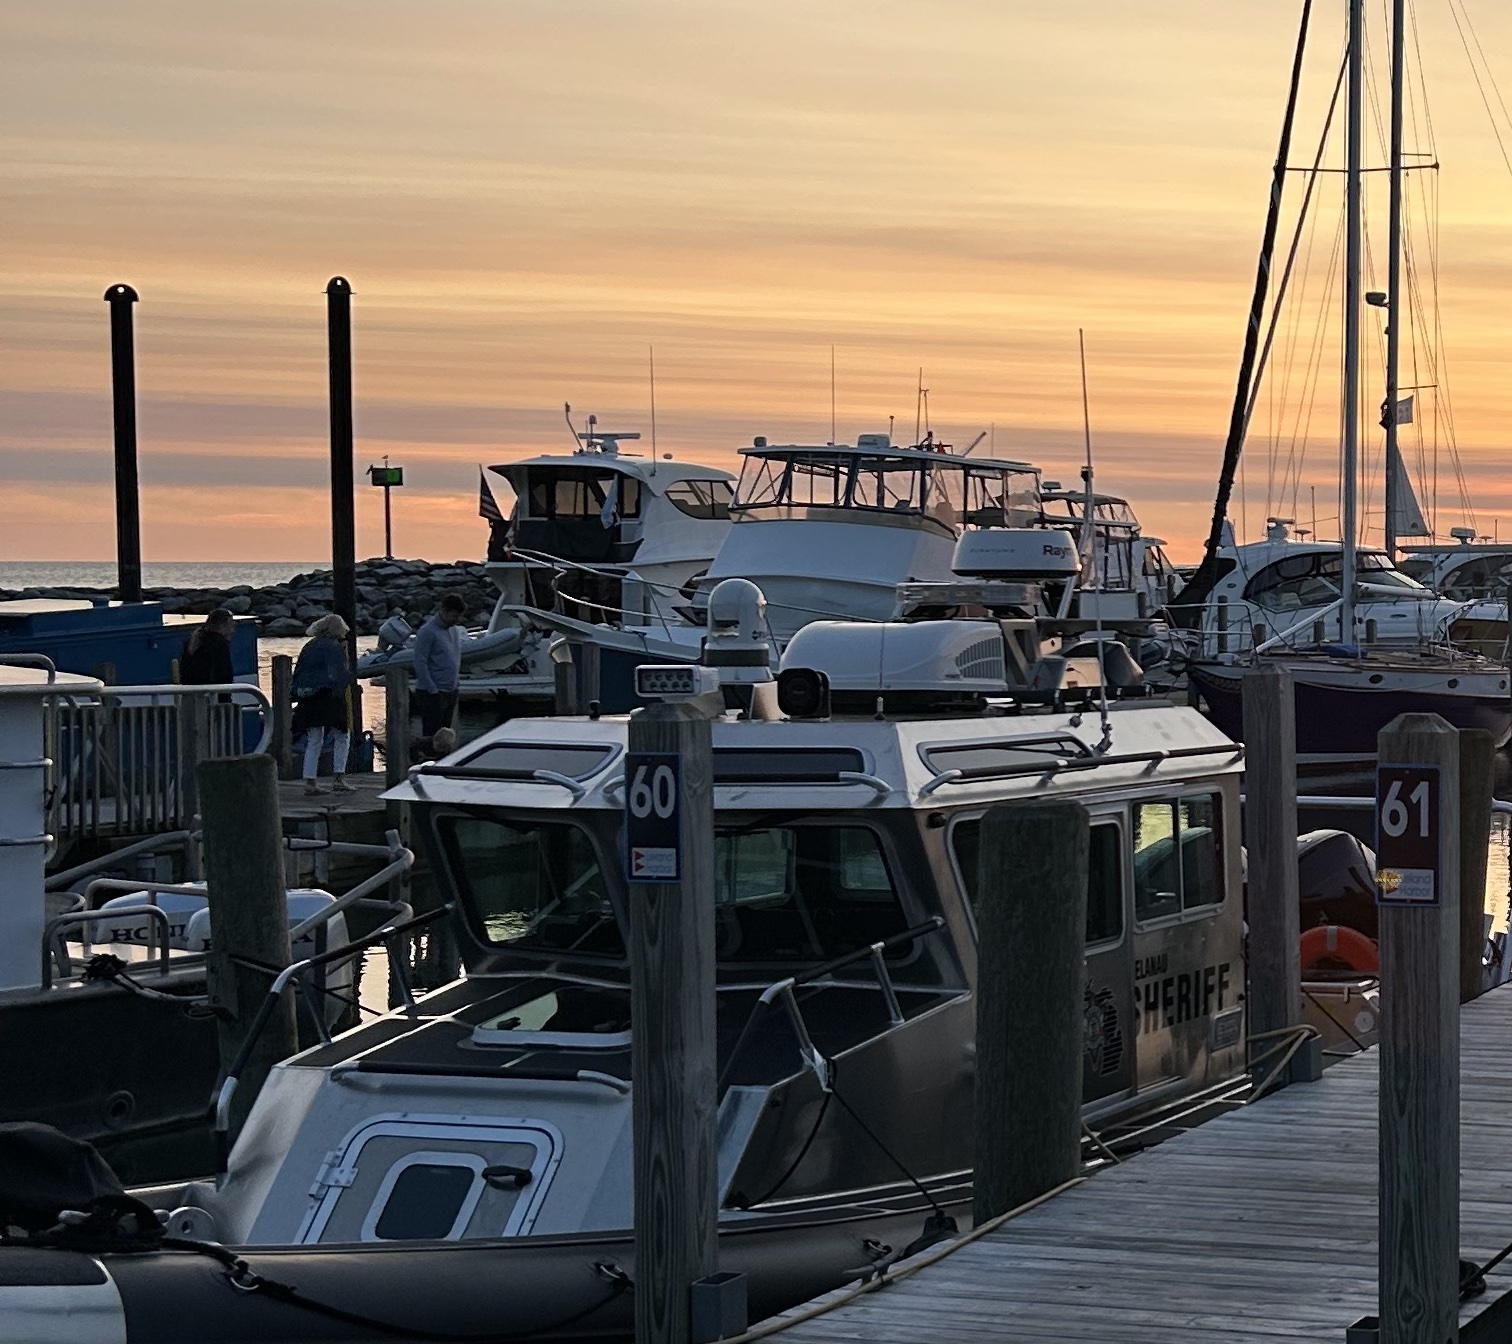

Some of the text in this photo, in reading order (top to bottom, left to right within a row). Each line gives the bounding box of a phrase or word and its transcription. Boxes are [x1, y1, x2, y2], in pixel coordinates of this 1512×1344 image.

[630, 764, 676, 819] 60
[1381, 780, 1430, 838] 61
[1135, 953, 1168, 981] ELANAU
[1135, 962, 1231, 1036] SHERIFF
